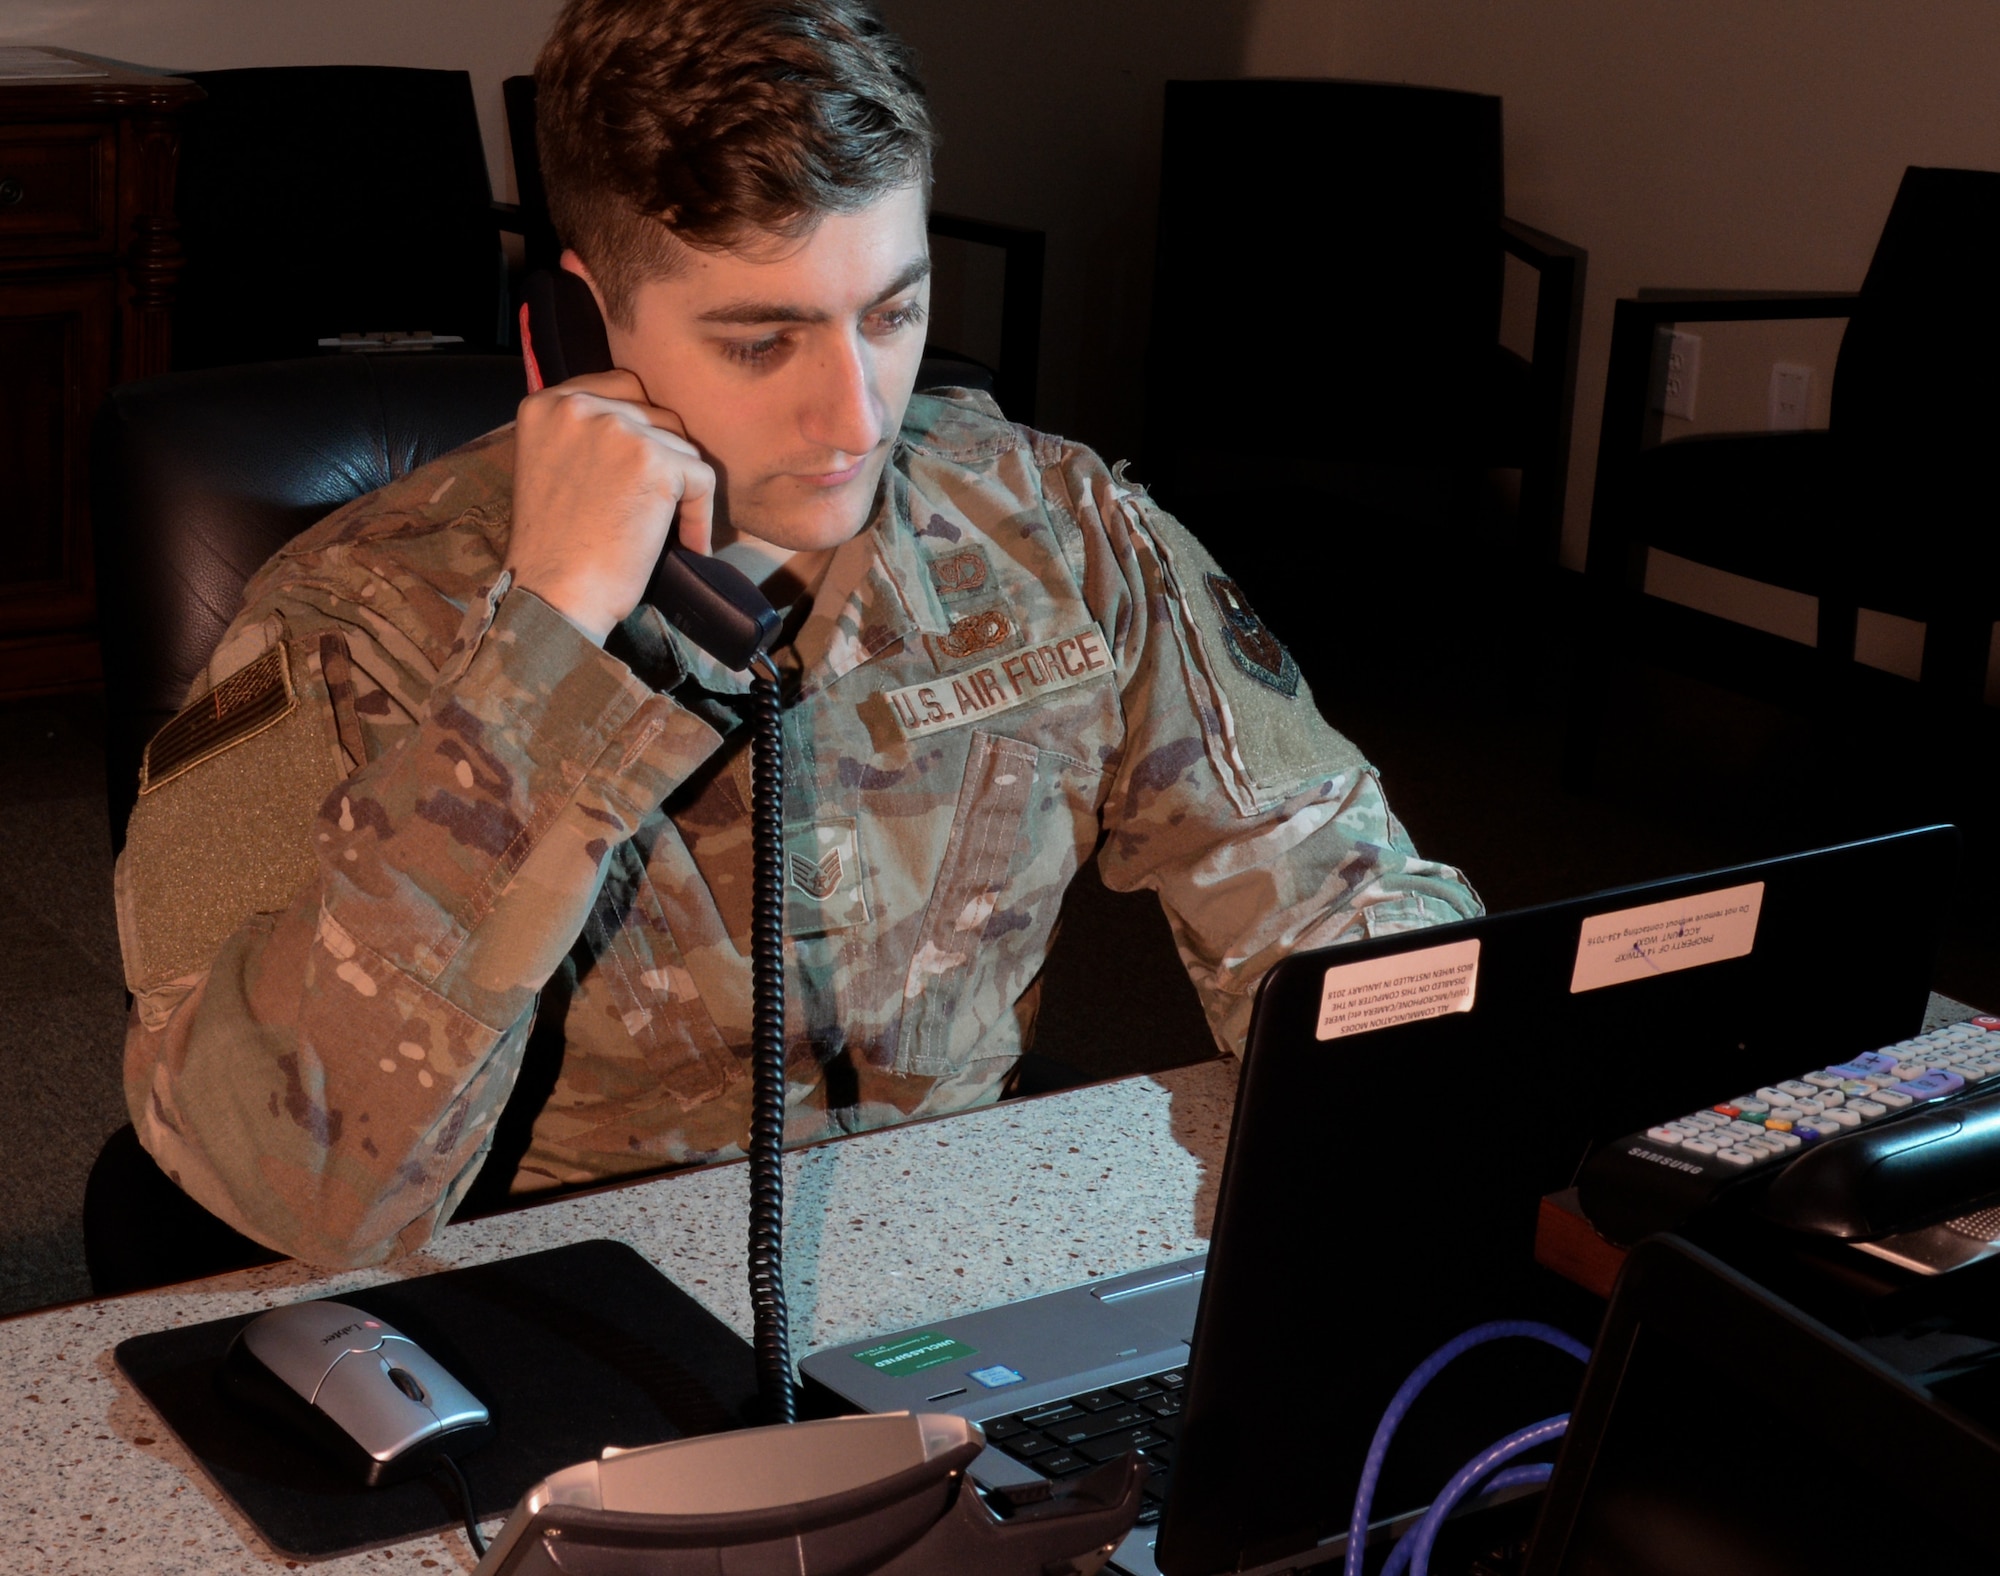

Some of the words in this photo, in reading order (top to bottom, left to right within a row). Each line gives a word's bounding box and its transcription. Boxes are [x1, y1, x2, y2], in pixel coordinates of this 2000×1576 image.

[891, 687, 955, 730] U.S.
[952, 668, 1008, 715] AIR
[1001, 631, 1105, 696] FORCE
[1725, 907, 1738, 917] not
[1738, 905, 1750, 914] Do
[1695, 909, 1723, 922] remove
[1666, 916, 1694, 930] without
[1623, 921, 1664, 938] contacting
[1671, 934, 1714, 950] PROPERTY
[1647, 947, 1655, 956] 14
[1658, 944, 1670, 953] OF
[1432, 967, 1455, 978] WHEN
[1457, 963, 1474, 973] BIOS
[1384, 980, 1391, 988] IN
[1393, 972, 1431, 985] INSTALLED
[1432, 977, 1466, 990] DISABLED
[1348, 982, 1382, 995] JANUARY
[1401, 988, 1417, 997] THIS
[1419, 984, 1430, 993] ON
[1328, 990, 1346, 1000] 2018
[1358, 991, 1400, 1005] COMPUTER
[1331, 1003, 1346, 1011] THE
[1348, 1000, 1356, 1008] IN
[1437, 1004, 1450, 1014] ALL
[1324, 1014, 1346, 1026] WERE
[1347, 1011, 1362, 1020] etc)
[1369, 1008, 1435, 1028] COMMUNICATION
[1340, 1022, 1369, 1034] MODES
[1918, 1079, 1938, 1088] CH
[1628, 1147, 1703, 1175] SAMSUNG
[320, 1322, 363, 1346] Labtec
[874, 1339, 956, 1368] UNCLASSIFIED
